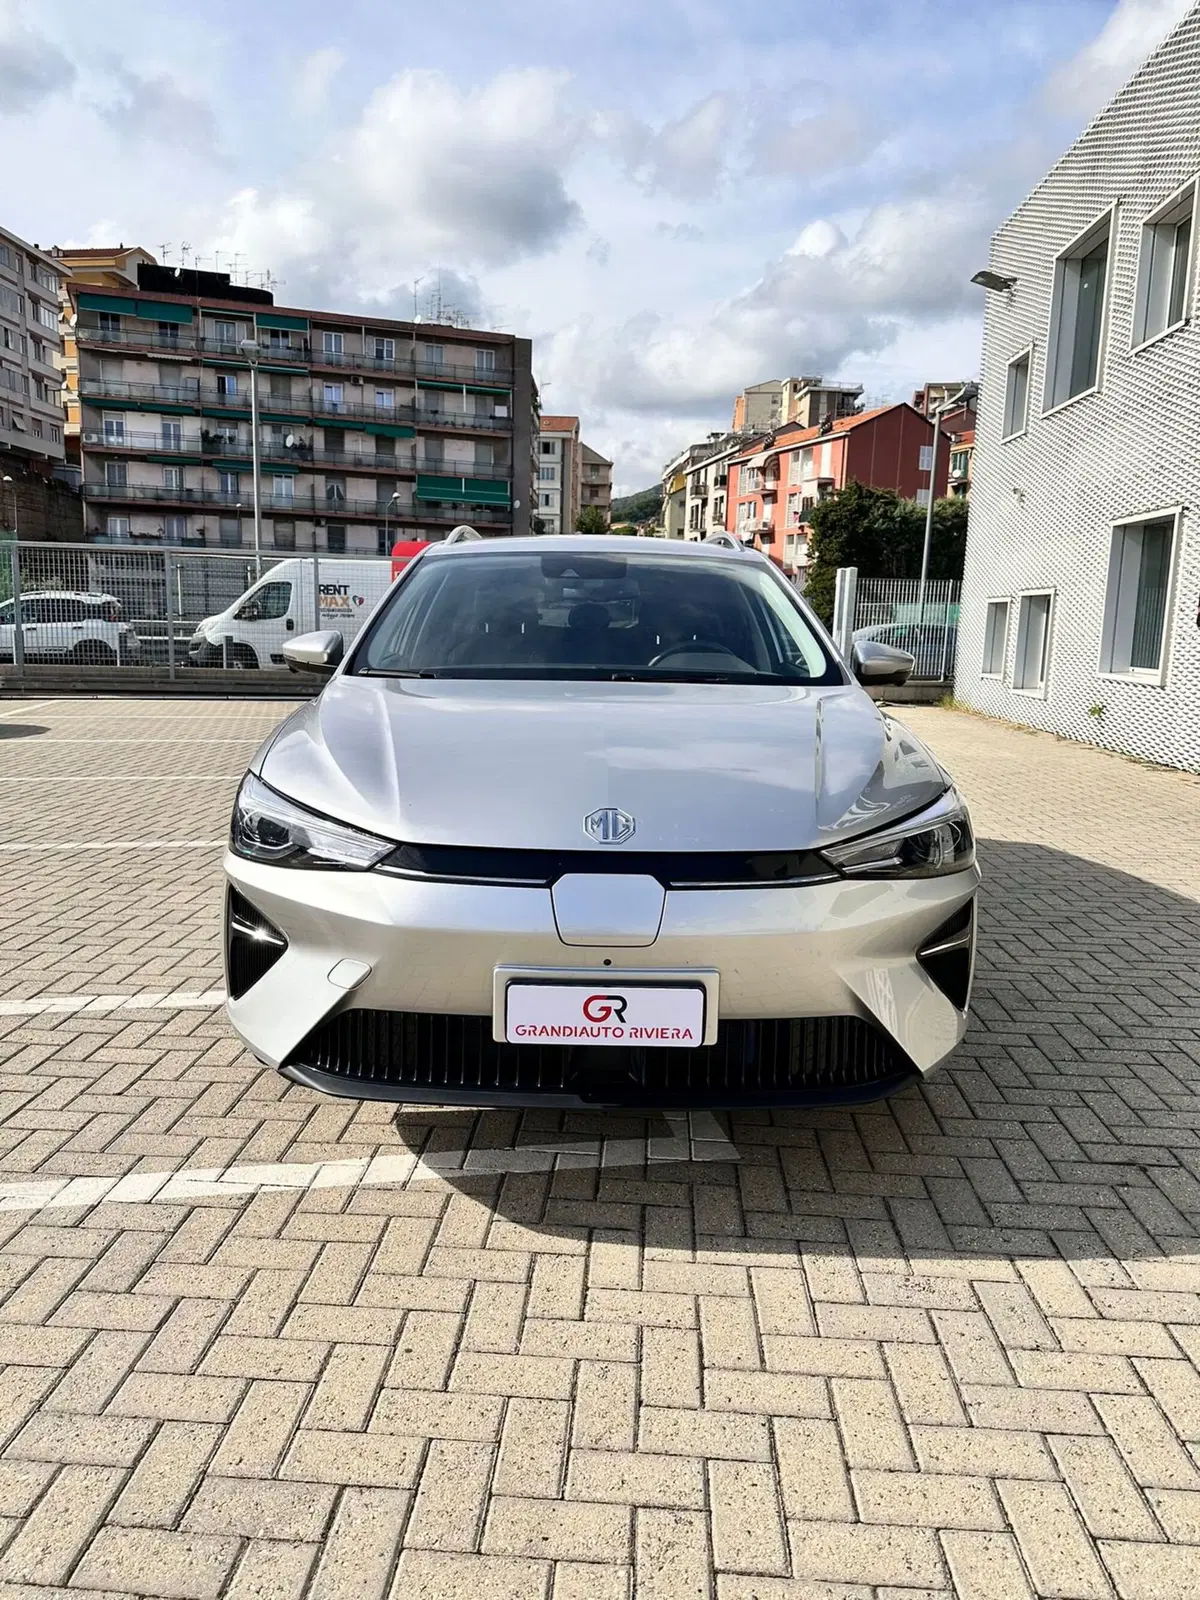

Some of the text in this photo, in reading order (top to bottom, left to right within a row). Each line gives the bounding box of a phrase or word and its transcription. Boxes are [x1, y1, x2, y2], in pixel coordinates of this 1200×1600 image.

[318, 584, 350, 596] RENT
[318, 595, 350, 608] MAX
[587, 810, 631, 841] MG
[582, 994, 628, 1024] GR
[515, 1024, 694, 1040] GRANDIAUTO RIVIERA
